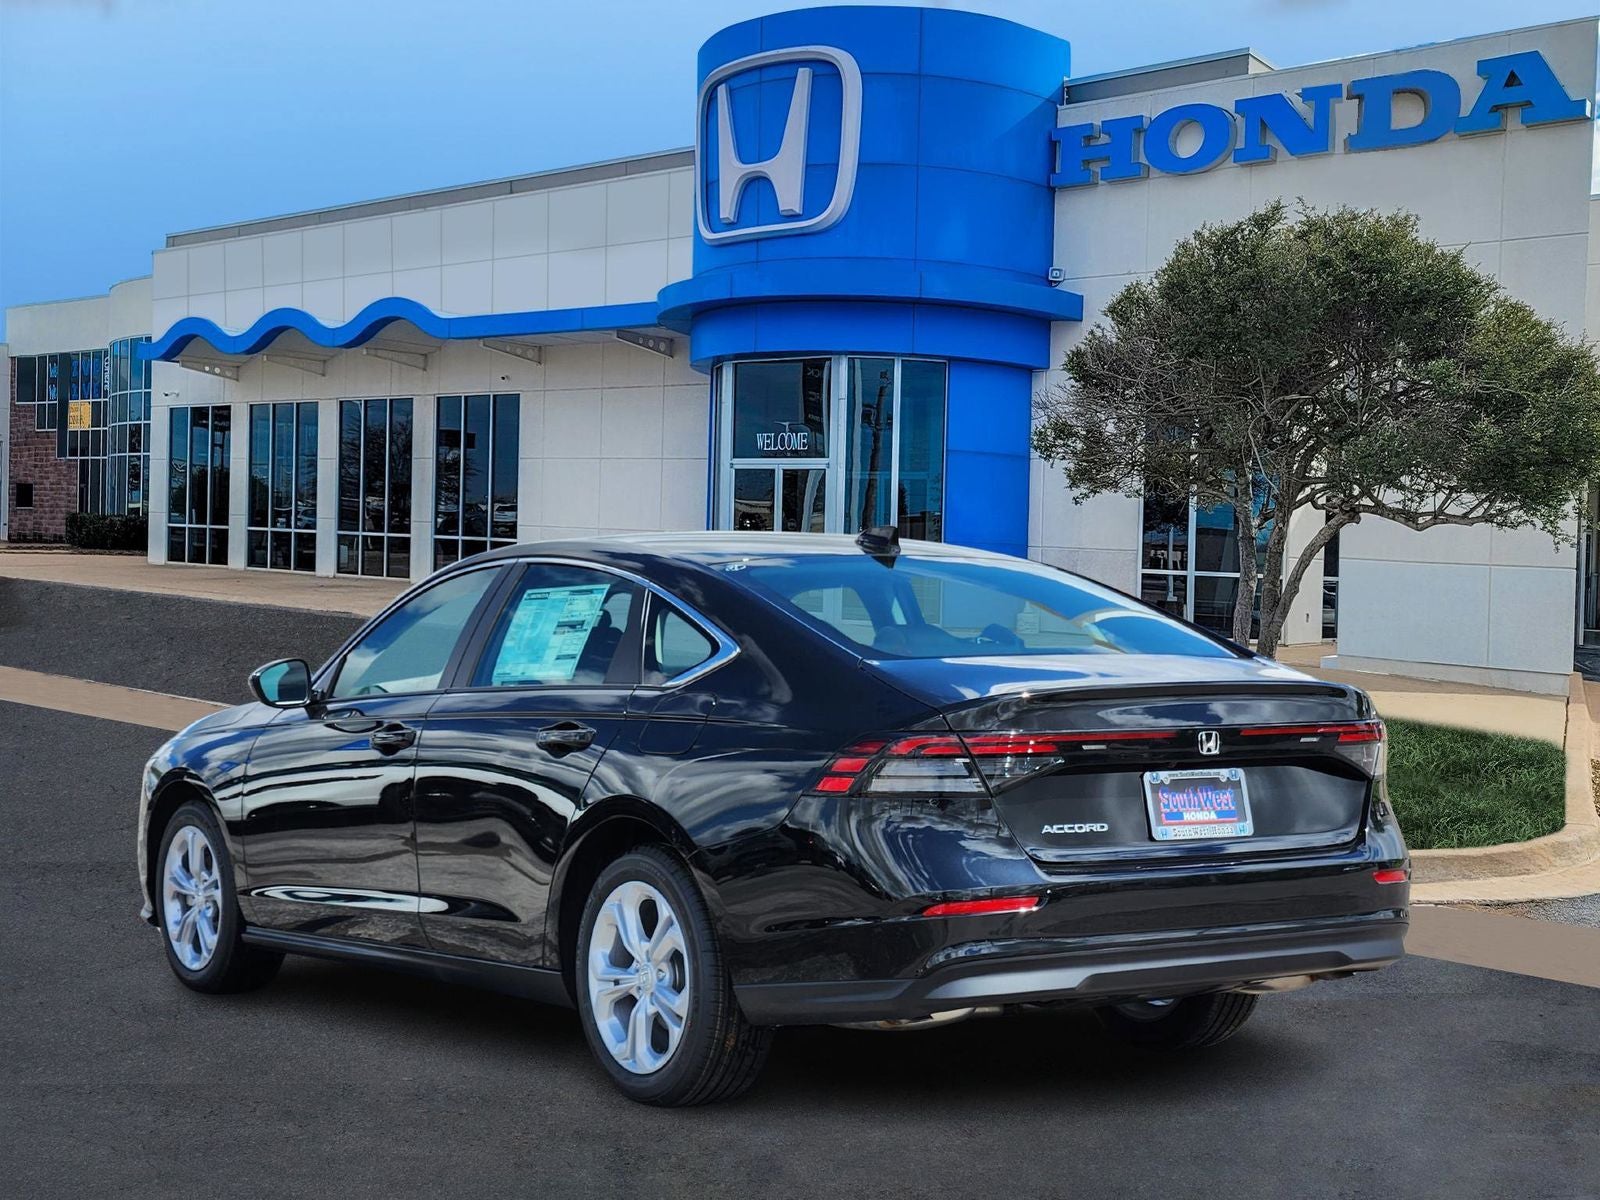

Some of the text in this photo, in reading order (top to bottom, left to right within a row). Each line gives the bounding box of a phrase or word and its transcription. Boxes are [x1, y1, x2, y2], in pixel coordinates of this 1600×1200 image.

[1050, 50, 1591, 188] HONDA
[756, 432, 808, 451] WELCOME
[1183, 811, 1218, 820] HONDA
[1041, 823, 1109, 834] ACCORD
